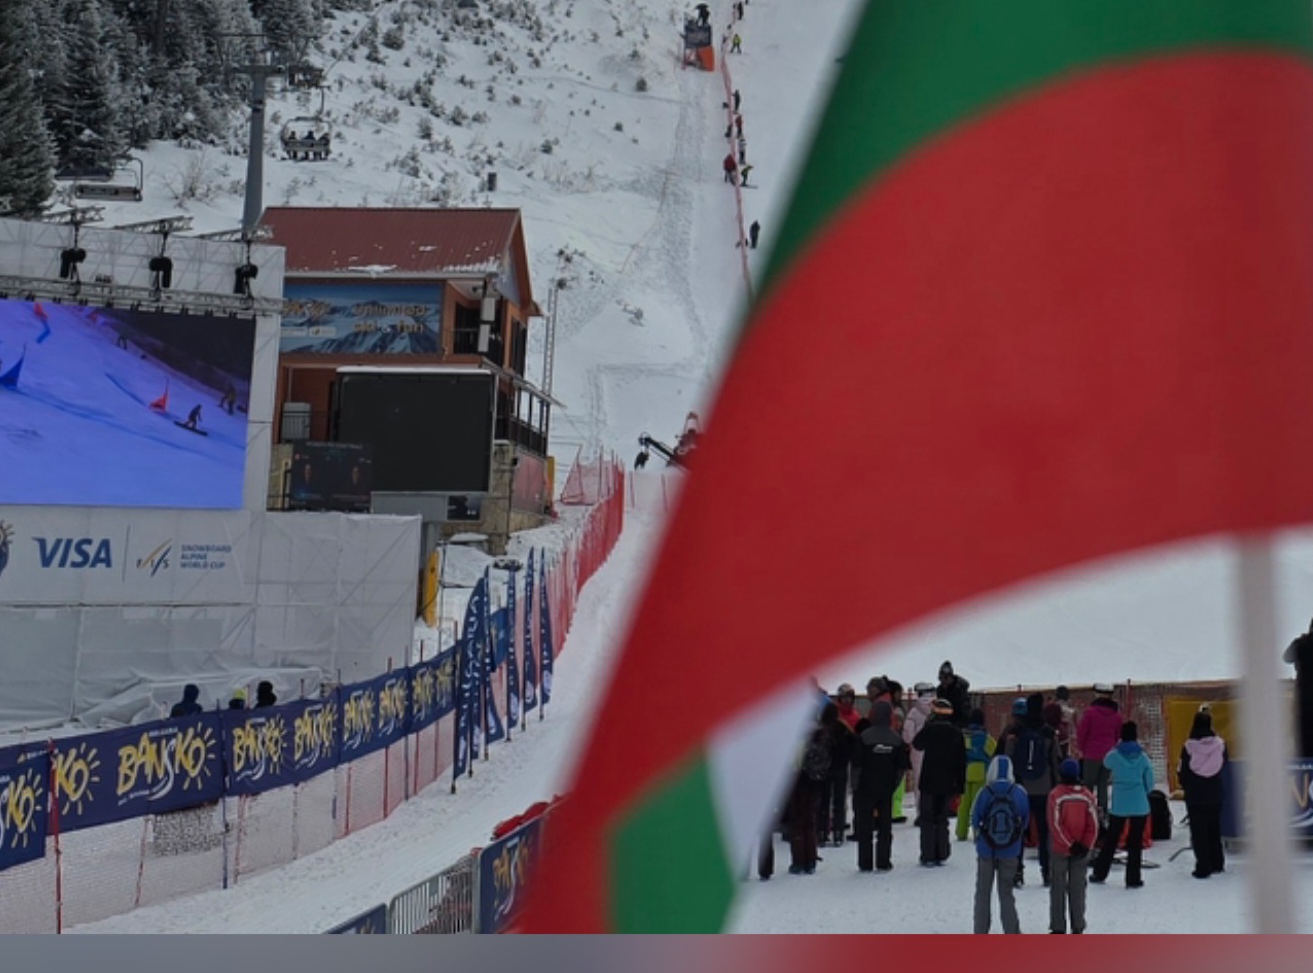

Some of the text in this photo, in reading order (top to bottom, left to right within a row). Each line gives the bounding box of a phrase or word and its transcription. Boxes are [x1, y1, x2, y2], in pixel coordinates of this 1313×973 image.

[32, 537, 112, 568] VISA
[180, 561, 226, 570] WORLD CUP
[117, 728, 206, 801] BANSKO
[233, 721, 282, 779] BANSKO
[294, 707, 333, 768] BANSKO
